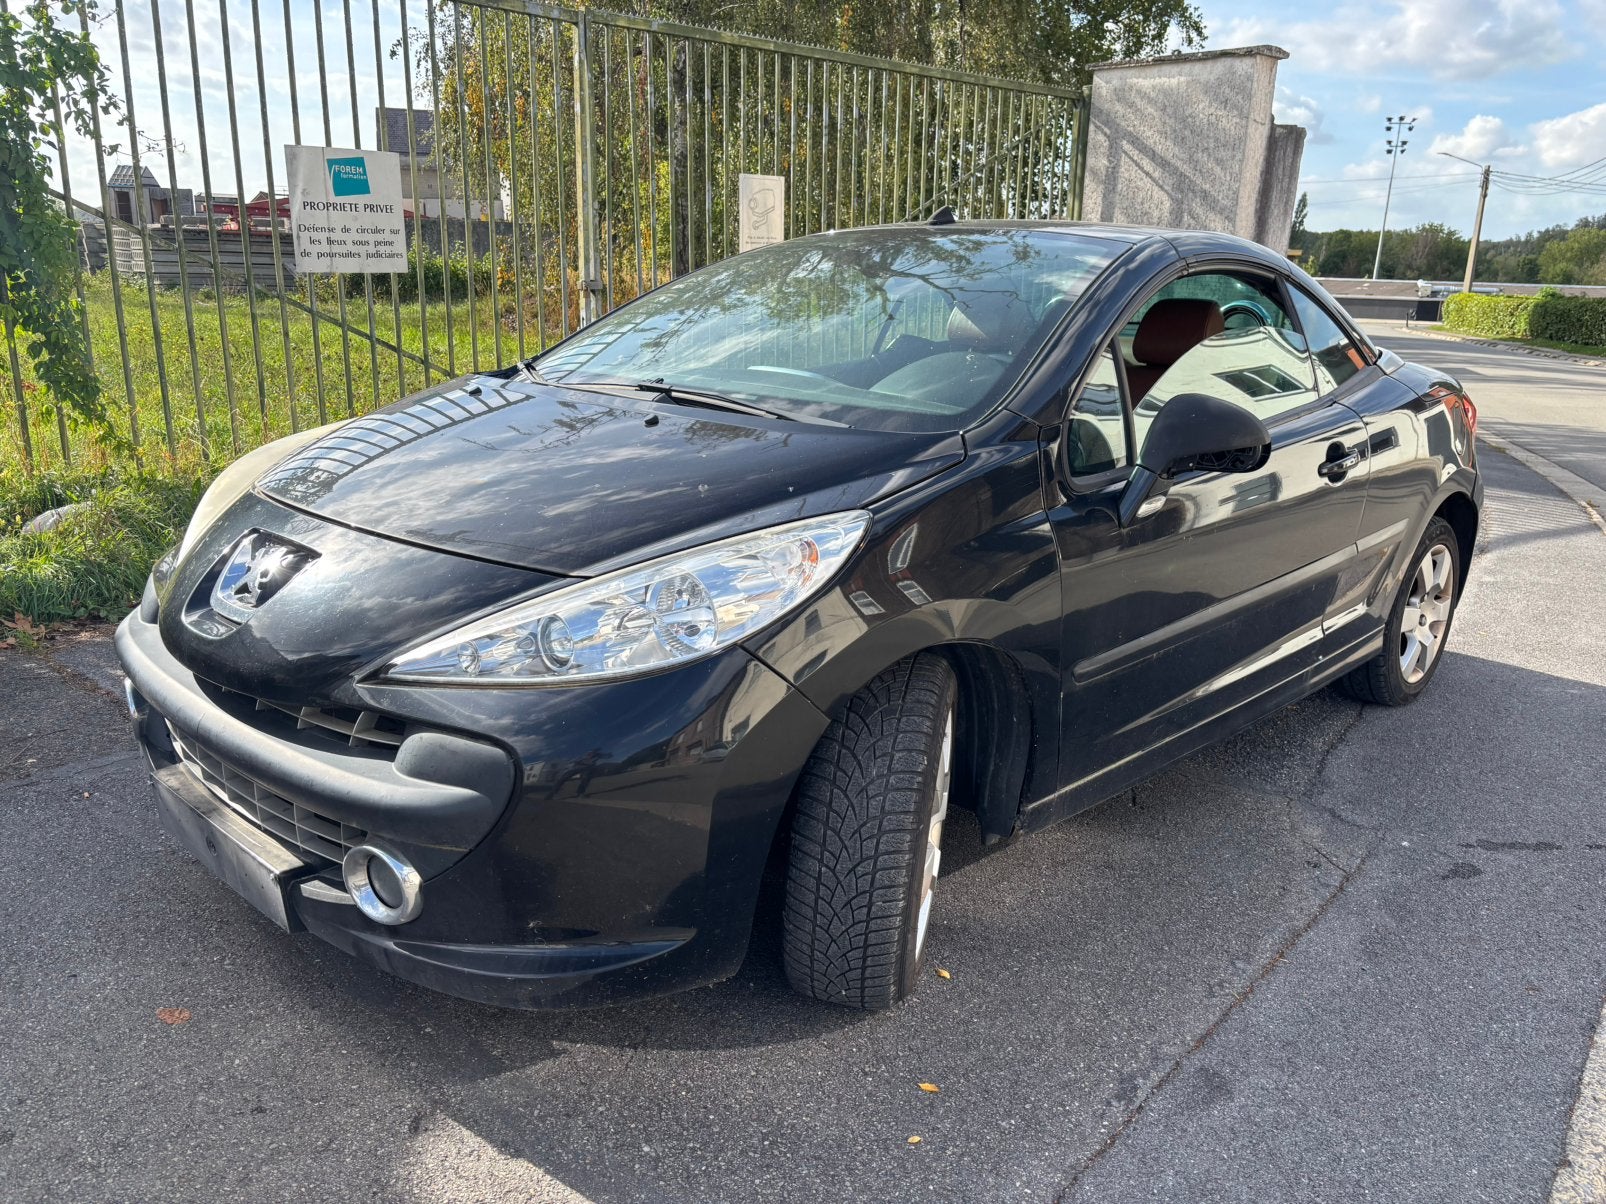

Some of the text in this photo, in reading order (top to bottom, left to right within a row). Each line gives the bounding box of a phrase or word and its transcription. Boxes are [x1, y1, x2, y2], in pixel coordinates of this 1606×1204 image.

[335, 165, 363, 174] FOREM
[302, 200, 395, 214] PROPRIETE PRIVEE
[298, 223, 337, 234] Défense
[340, 224, 352, 234] de
[356, 225, 386, 235] circuler
[309, 236, 322, 245] les
[326, 236, 347, 246] lieux
[373, 238, 395, 249] peine
[300, 249, 404, 260] de poursuites judiciaires
